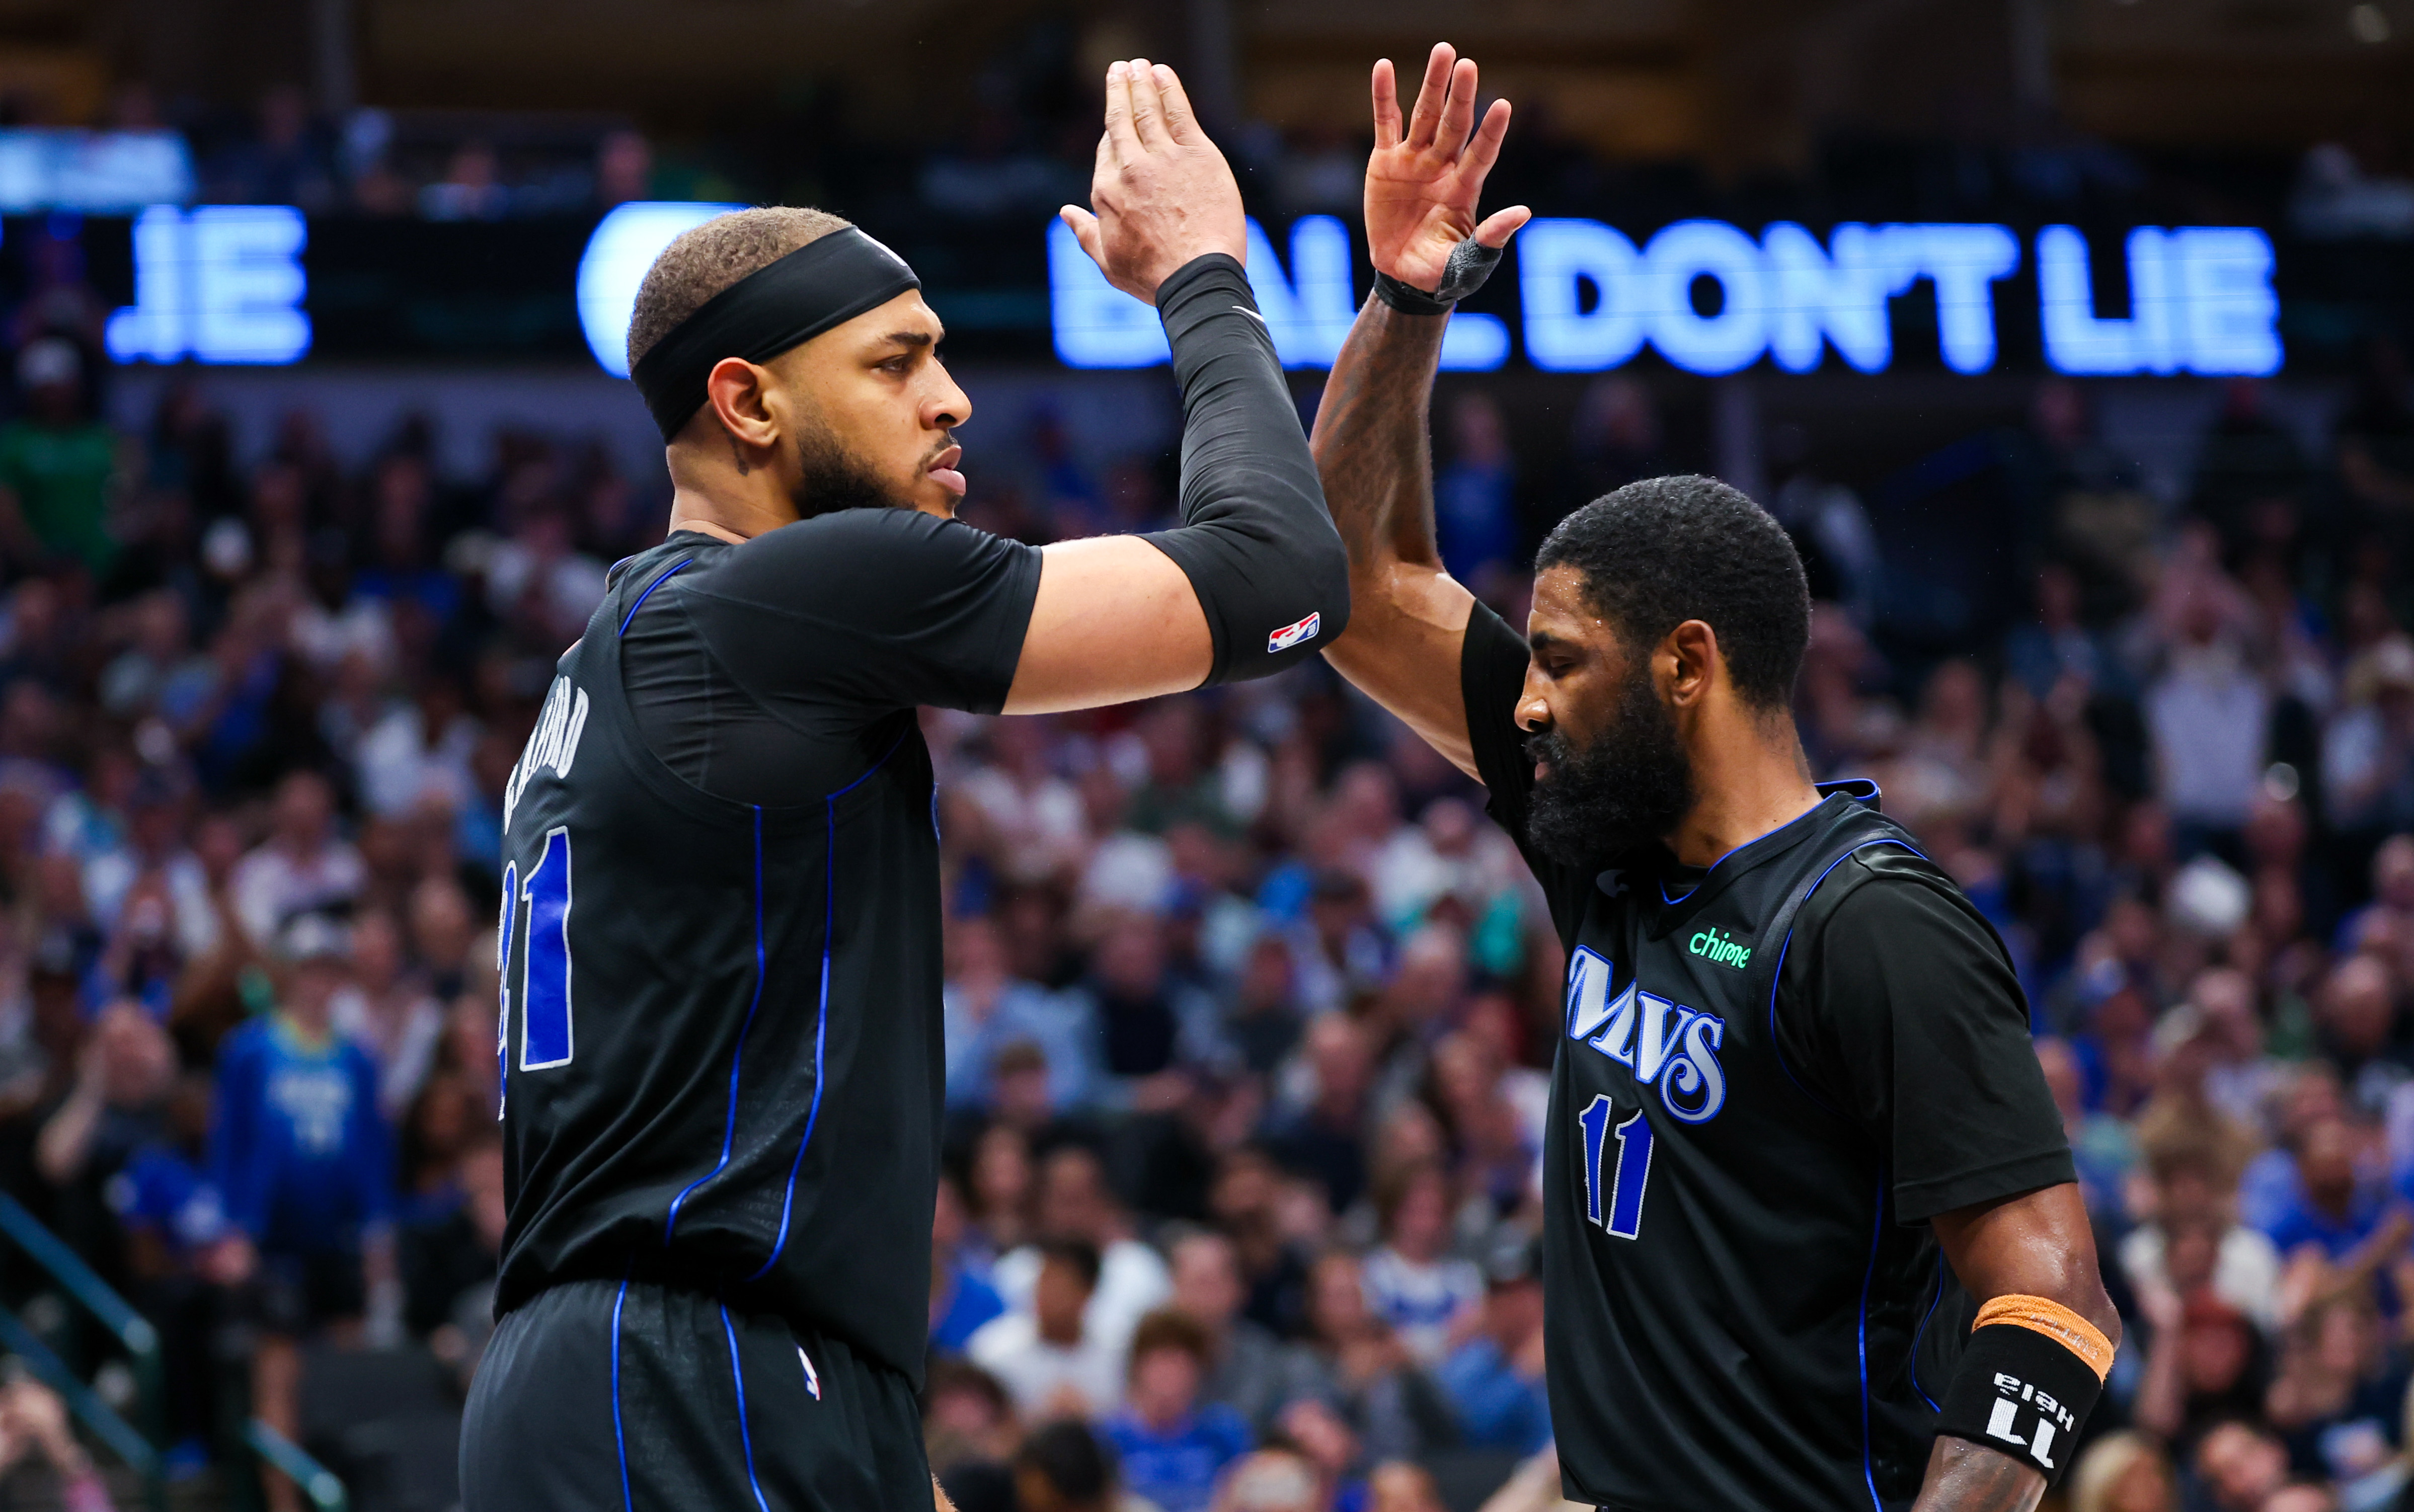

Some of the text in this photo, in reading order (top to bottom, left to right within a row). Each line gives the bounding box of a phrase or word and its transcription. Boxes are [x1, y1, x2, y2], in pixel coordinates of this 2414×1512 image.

[103, 203, 311, 364] IE
[1517, 217, 2018, 375] DON'T
[2037, 224, 2285, 377] LIE
[1689, 927, 1751, 969] chime
[1566, 944, 1727, 1125] MVS
[1579, 1093, 1655, 1240] 11
[1986, 1397, 2056, 1469] 11
